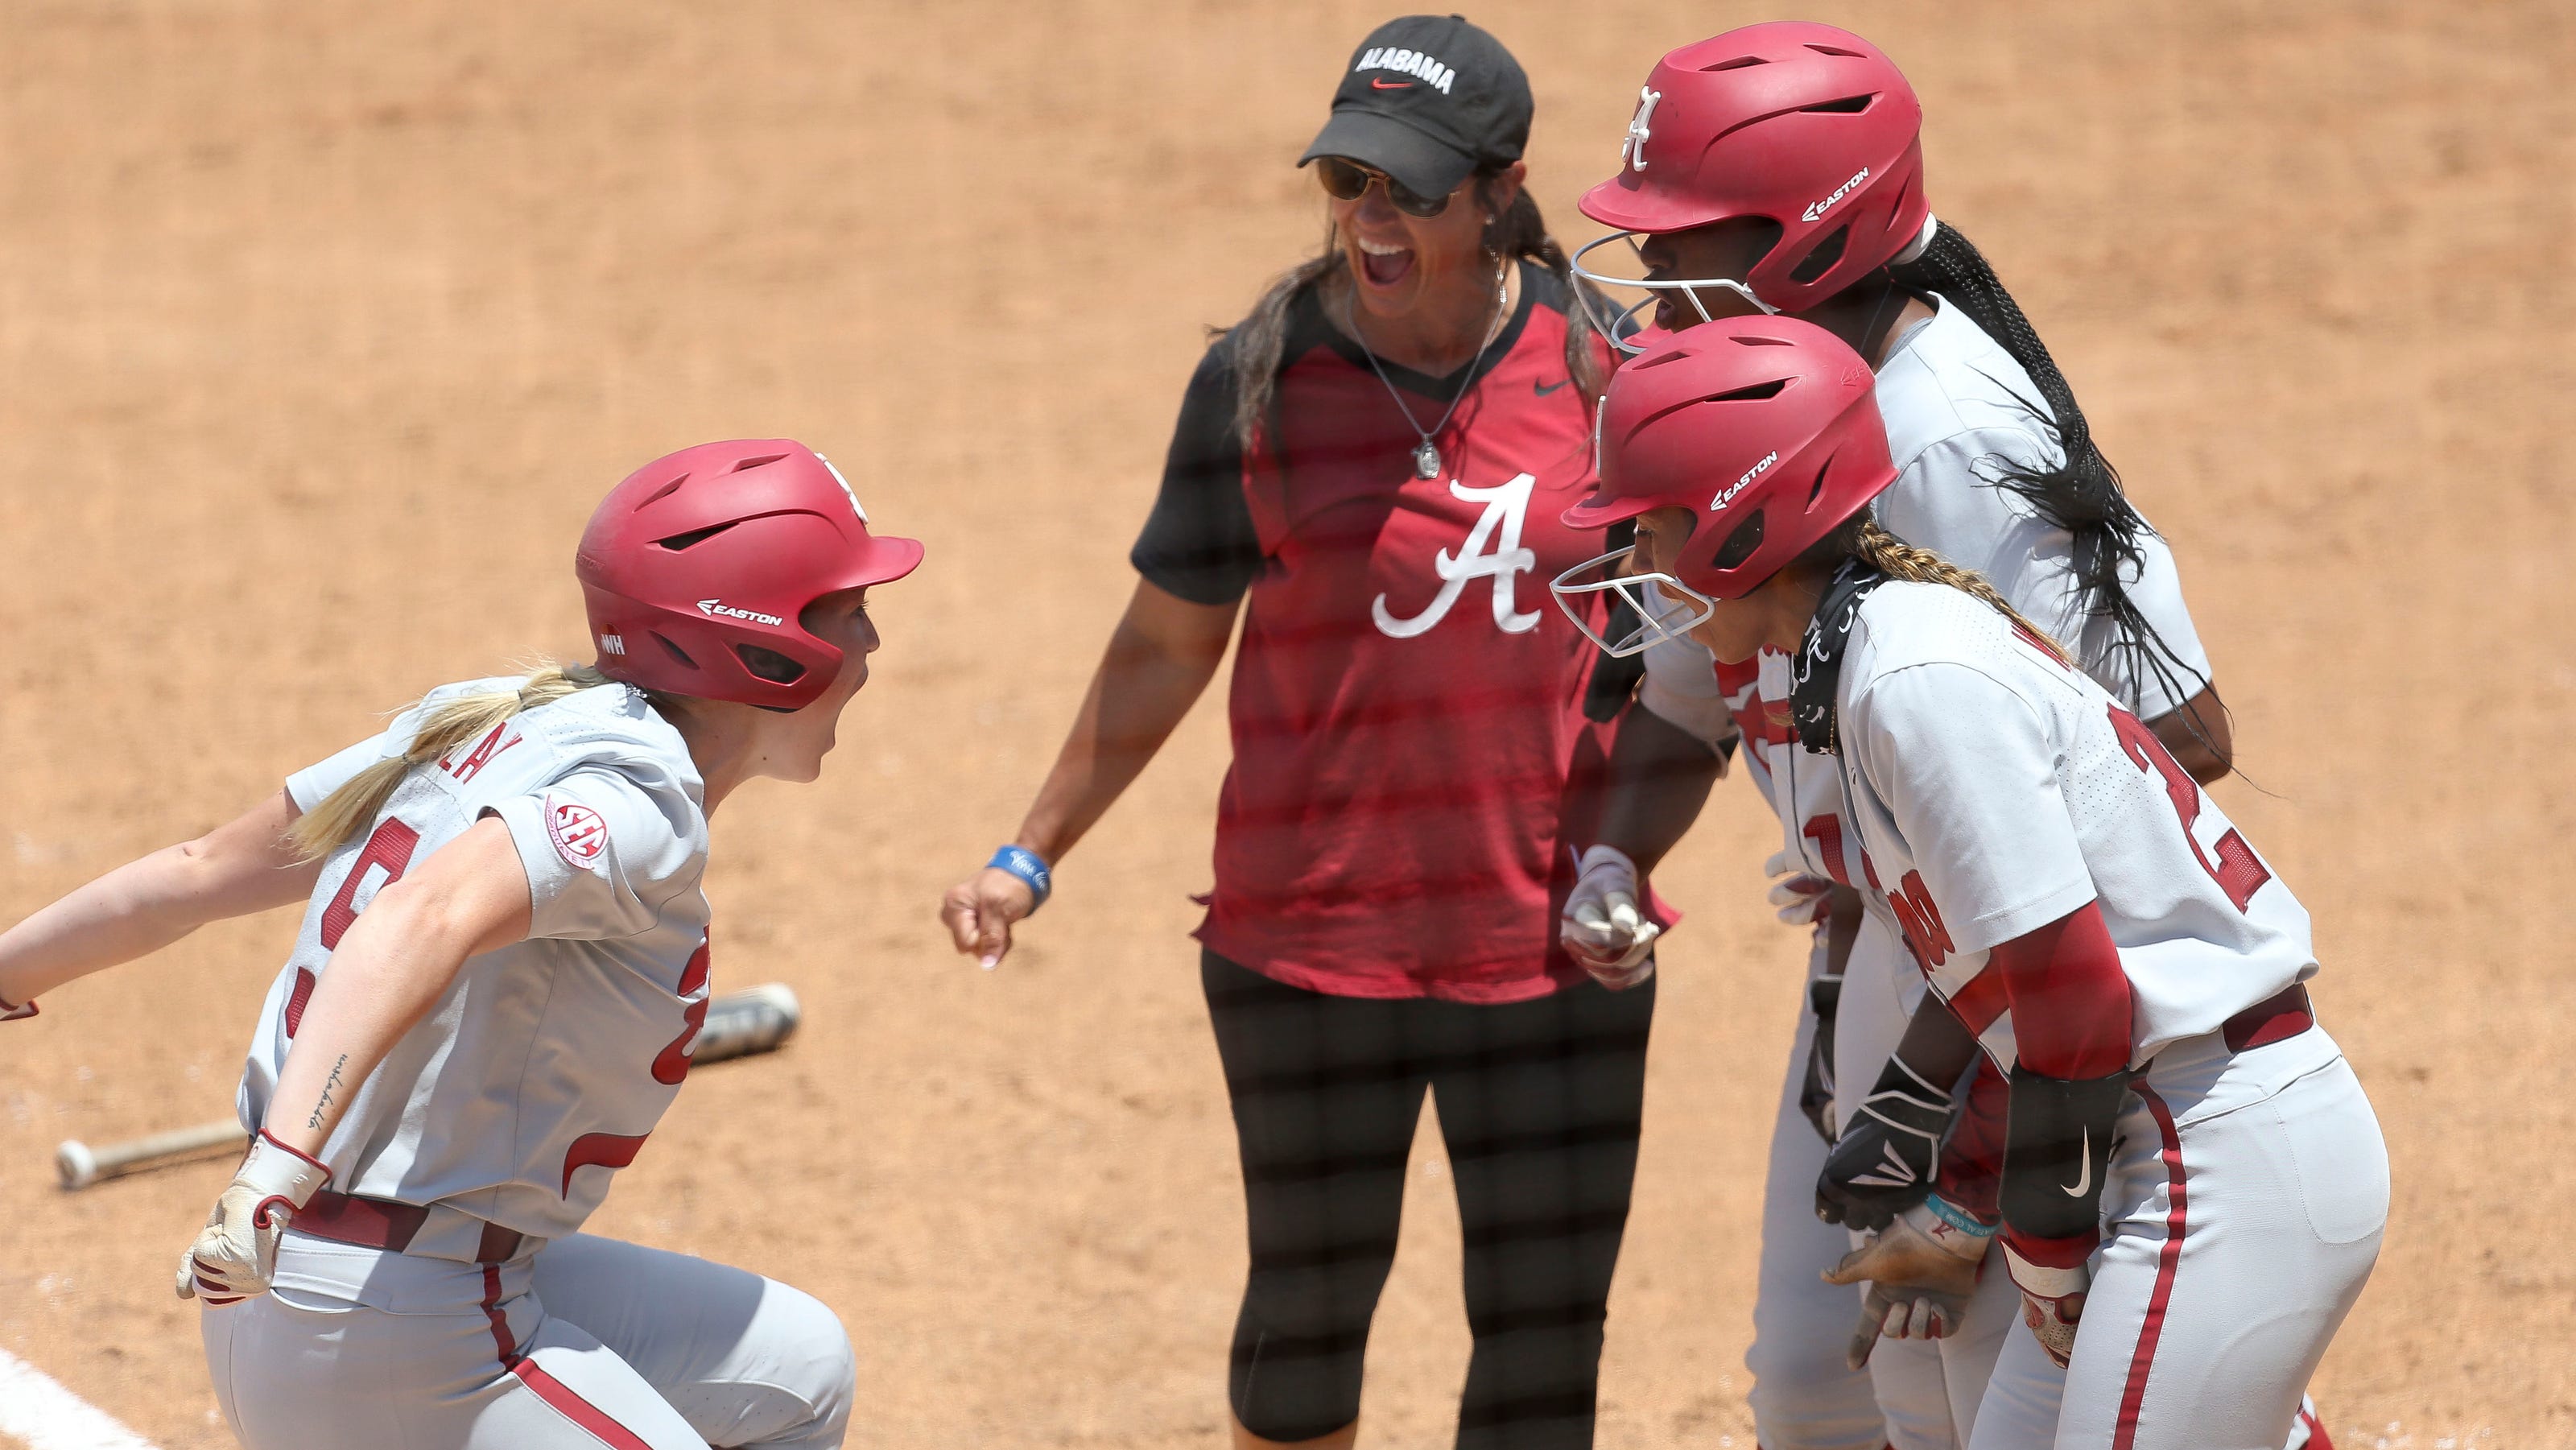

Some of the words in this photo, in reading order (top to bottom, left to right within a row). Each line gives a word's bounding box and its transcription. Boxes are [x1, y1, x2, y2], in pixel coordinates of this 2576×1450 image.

[1355, 47, 1455, 95] ALABAMA
[1816, 166, 1869, 215] EASTON
[1723, 450, 1777, 502] EASTON
[1372, 473, 1542, 638] A
[712, 605, 782, 626] EASTON
[555, 806, 606, 856] SEC
[2107, 701, 2272, 915] 2
